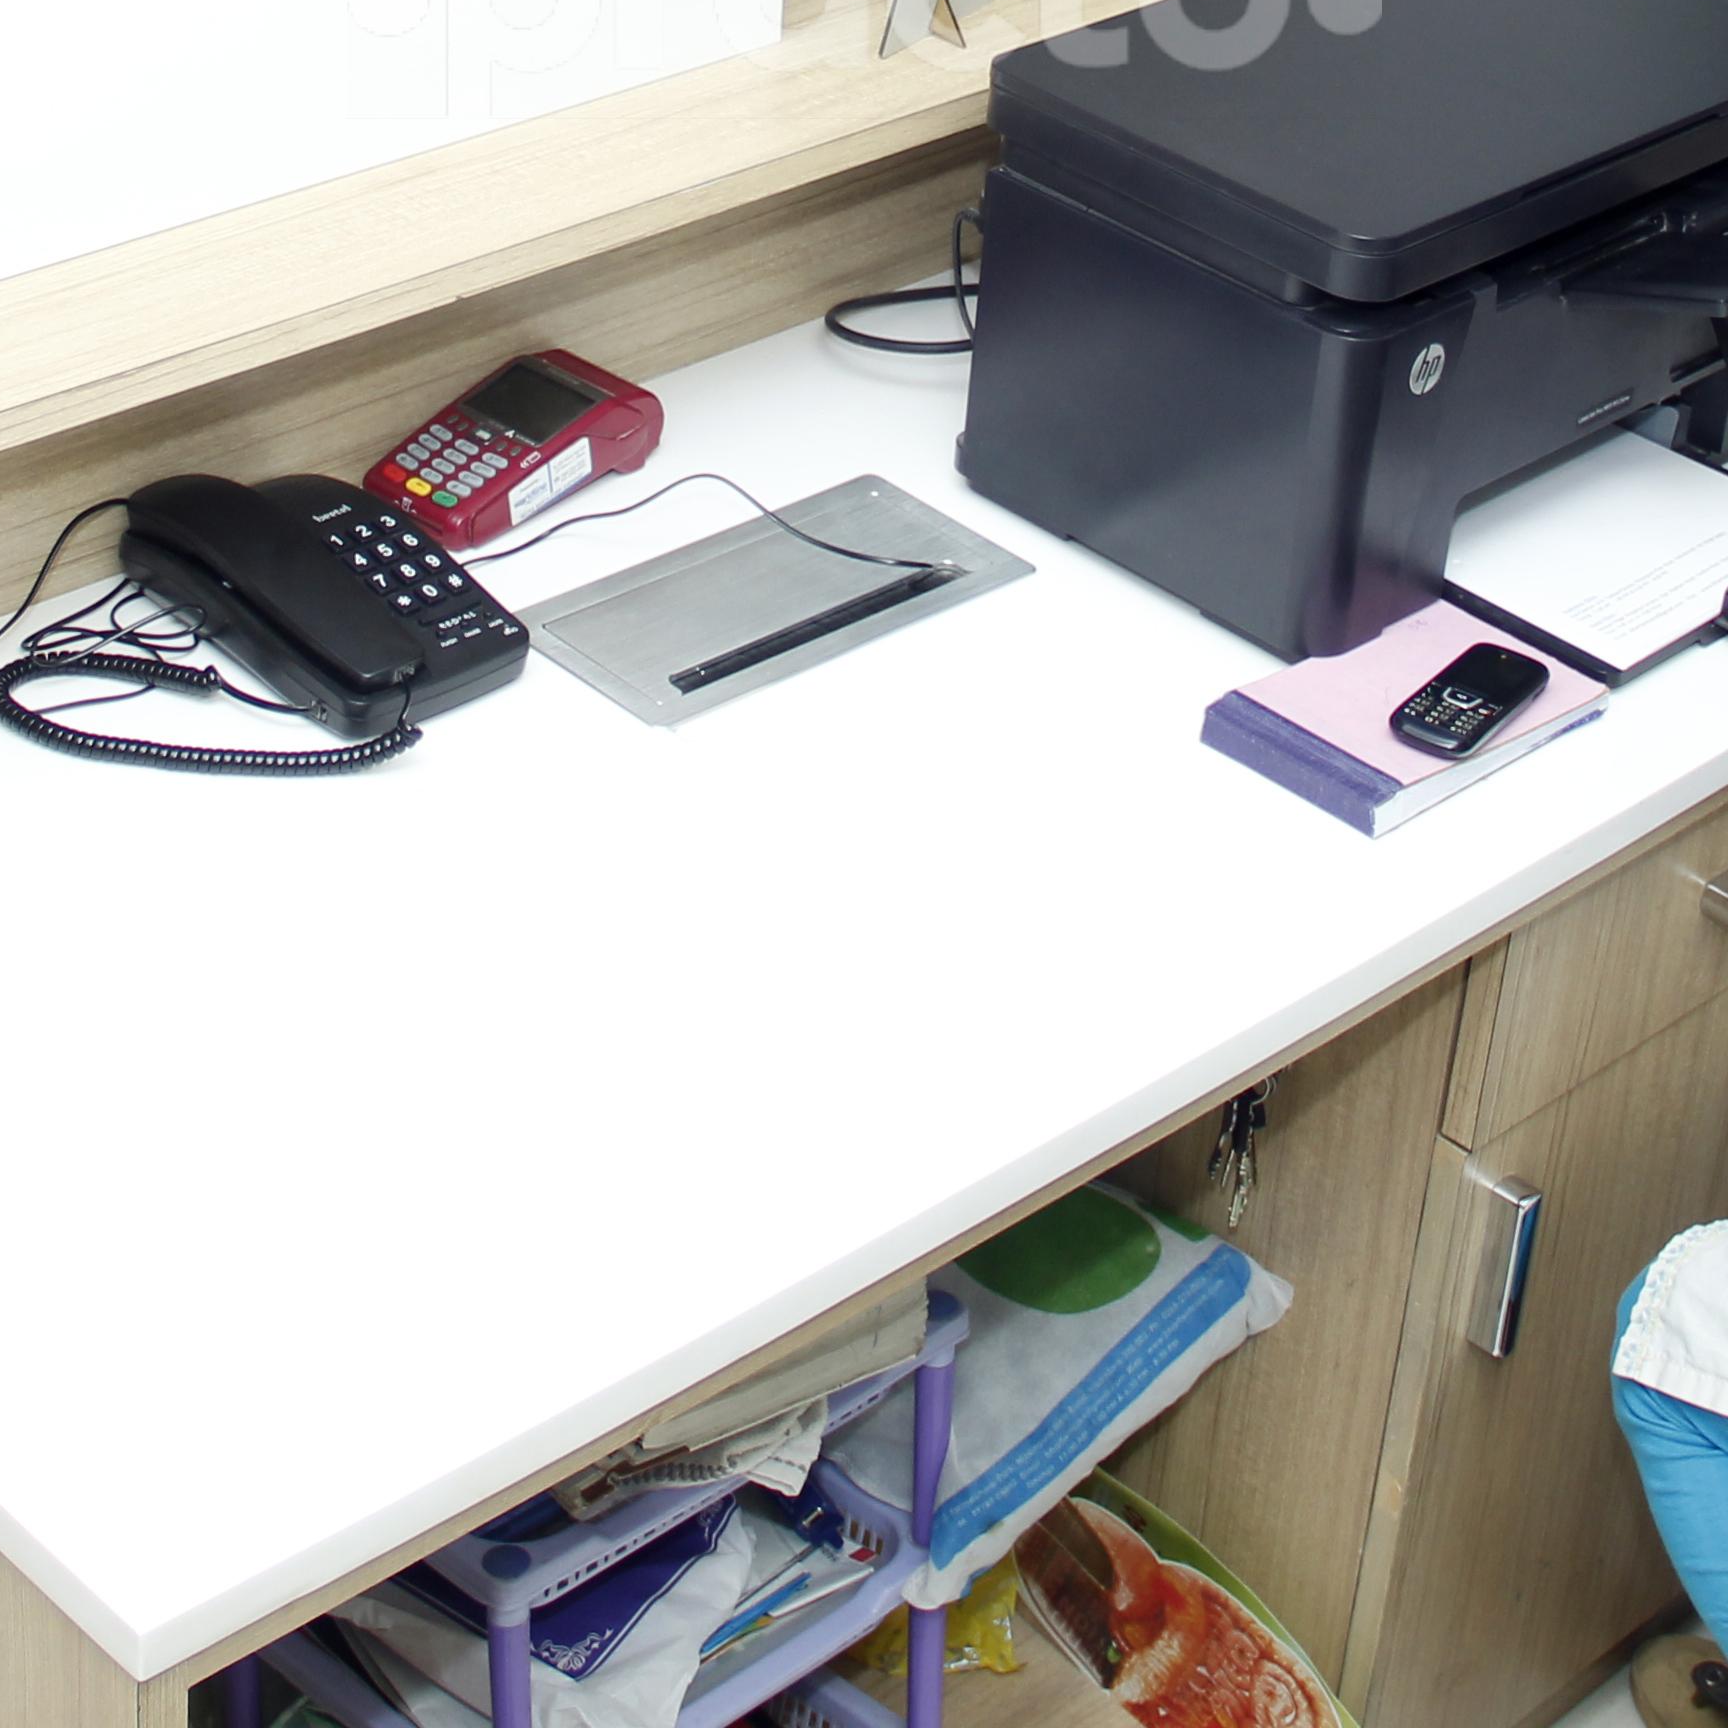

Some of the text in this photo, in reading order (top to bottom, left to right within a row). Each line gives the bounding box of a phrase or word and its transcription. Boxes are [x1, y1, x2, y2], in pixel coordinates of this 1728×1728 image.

[1413, 343, 1443, 395] hp
[330, 515, 396, 547] 1 2 3
[353, 534, 419, 566] 4 5 6
[372, 554, 441, 588] 7 8 9
[422, 584, 438, 597] 0
